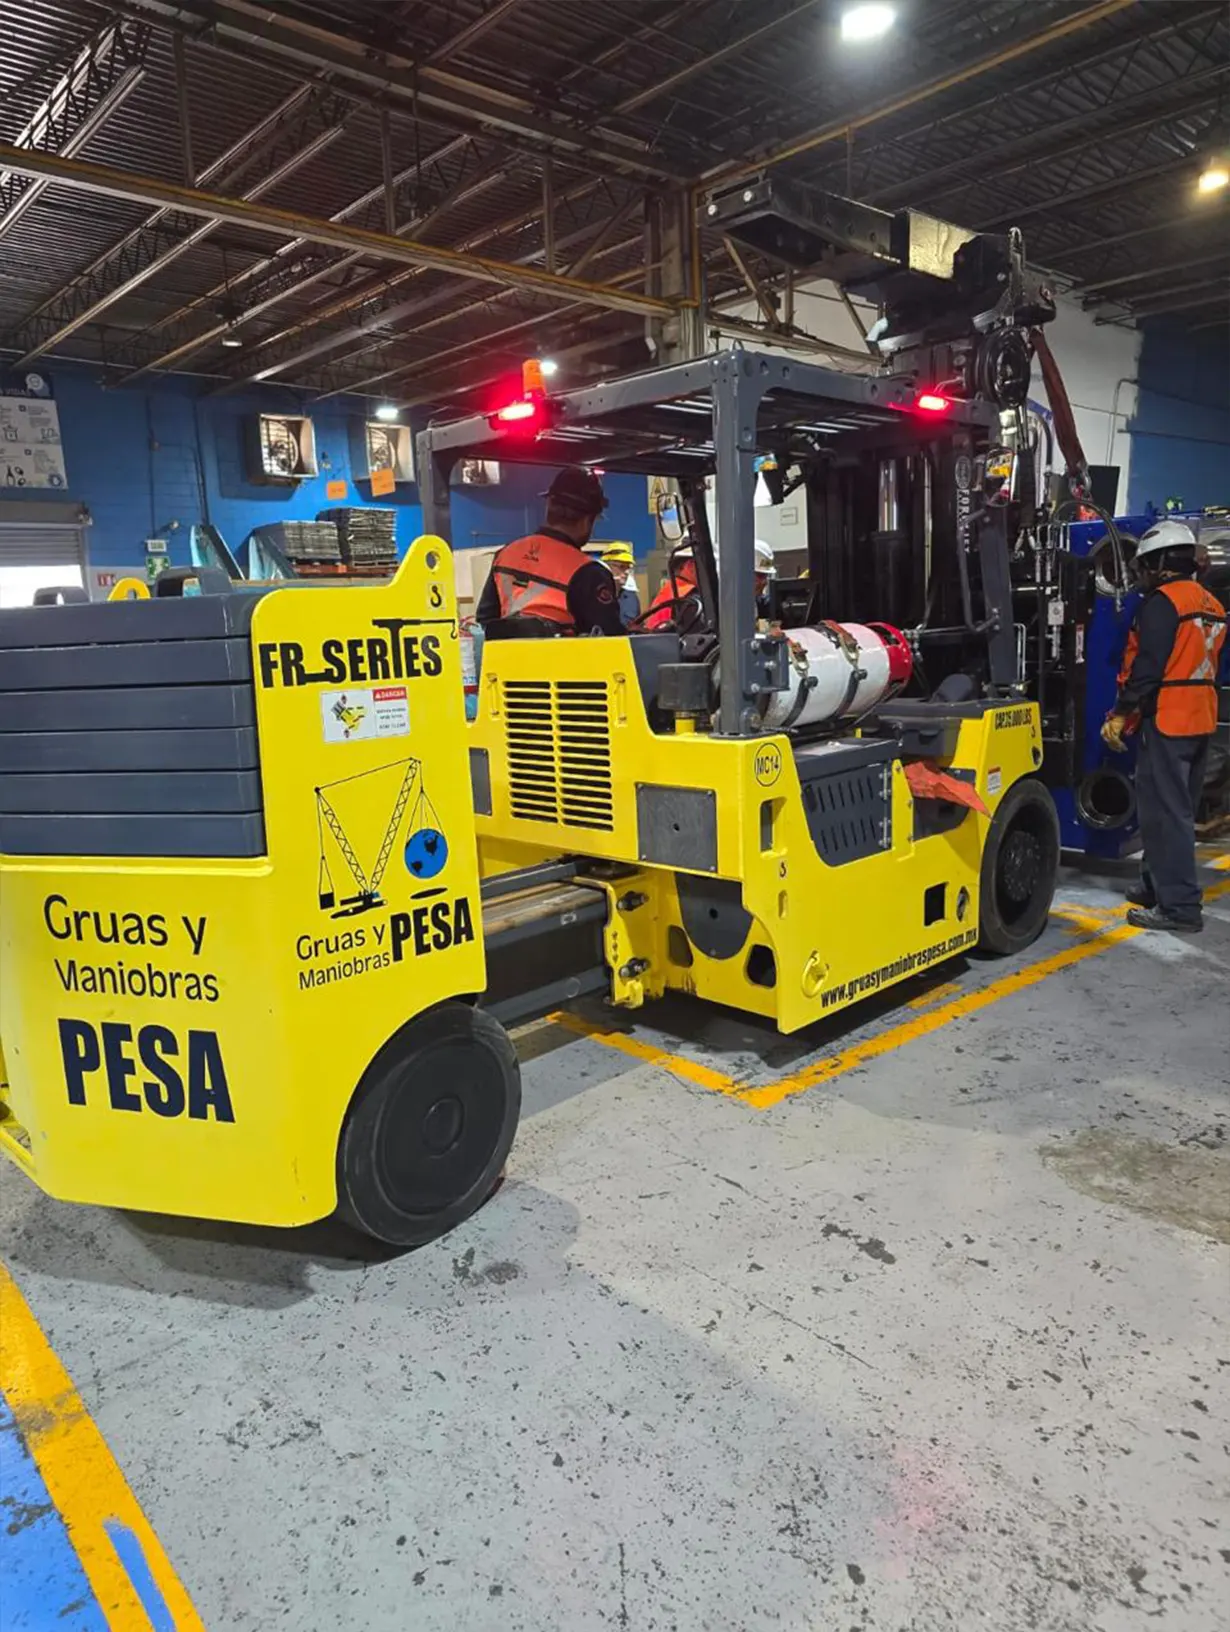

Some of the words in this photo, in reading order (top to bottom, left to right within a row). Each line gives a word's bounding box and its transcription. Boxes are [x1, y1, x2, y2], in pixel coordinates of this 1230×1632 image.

[757, 755, 779, 775] MC14
[44, 894, 168, 946] Gruas
[182, 916, 206, 955] y
[296, 928, 366, 960] Gruas
[373, 924, 386, 945] y
[390, 897, 474, 962] PESA
[298, 952, 390, 990] Maniobras
[821, 928, 977, 1008] www.gruasymaniobraspesa.com.mx
[58, 1018, 236, 1123] PESA
